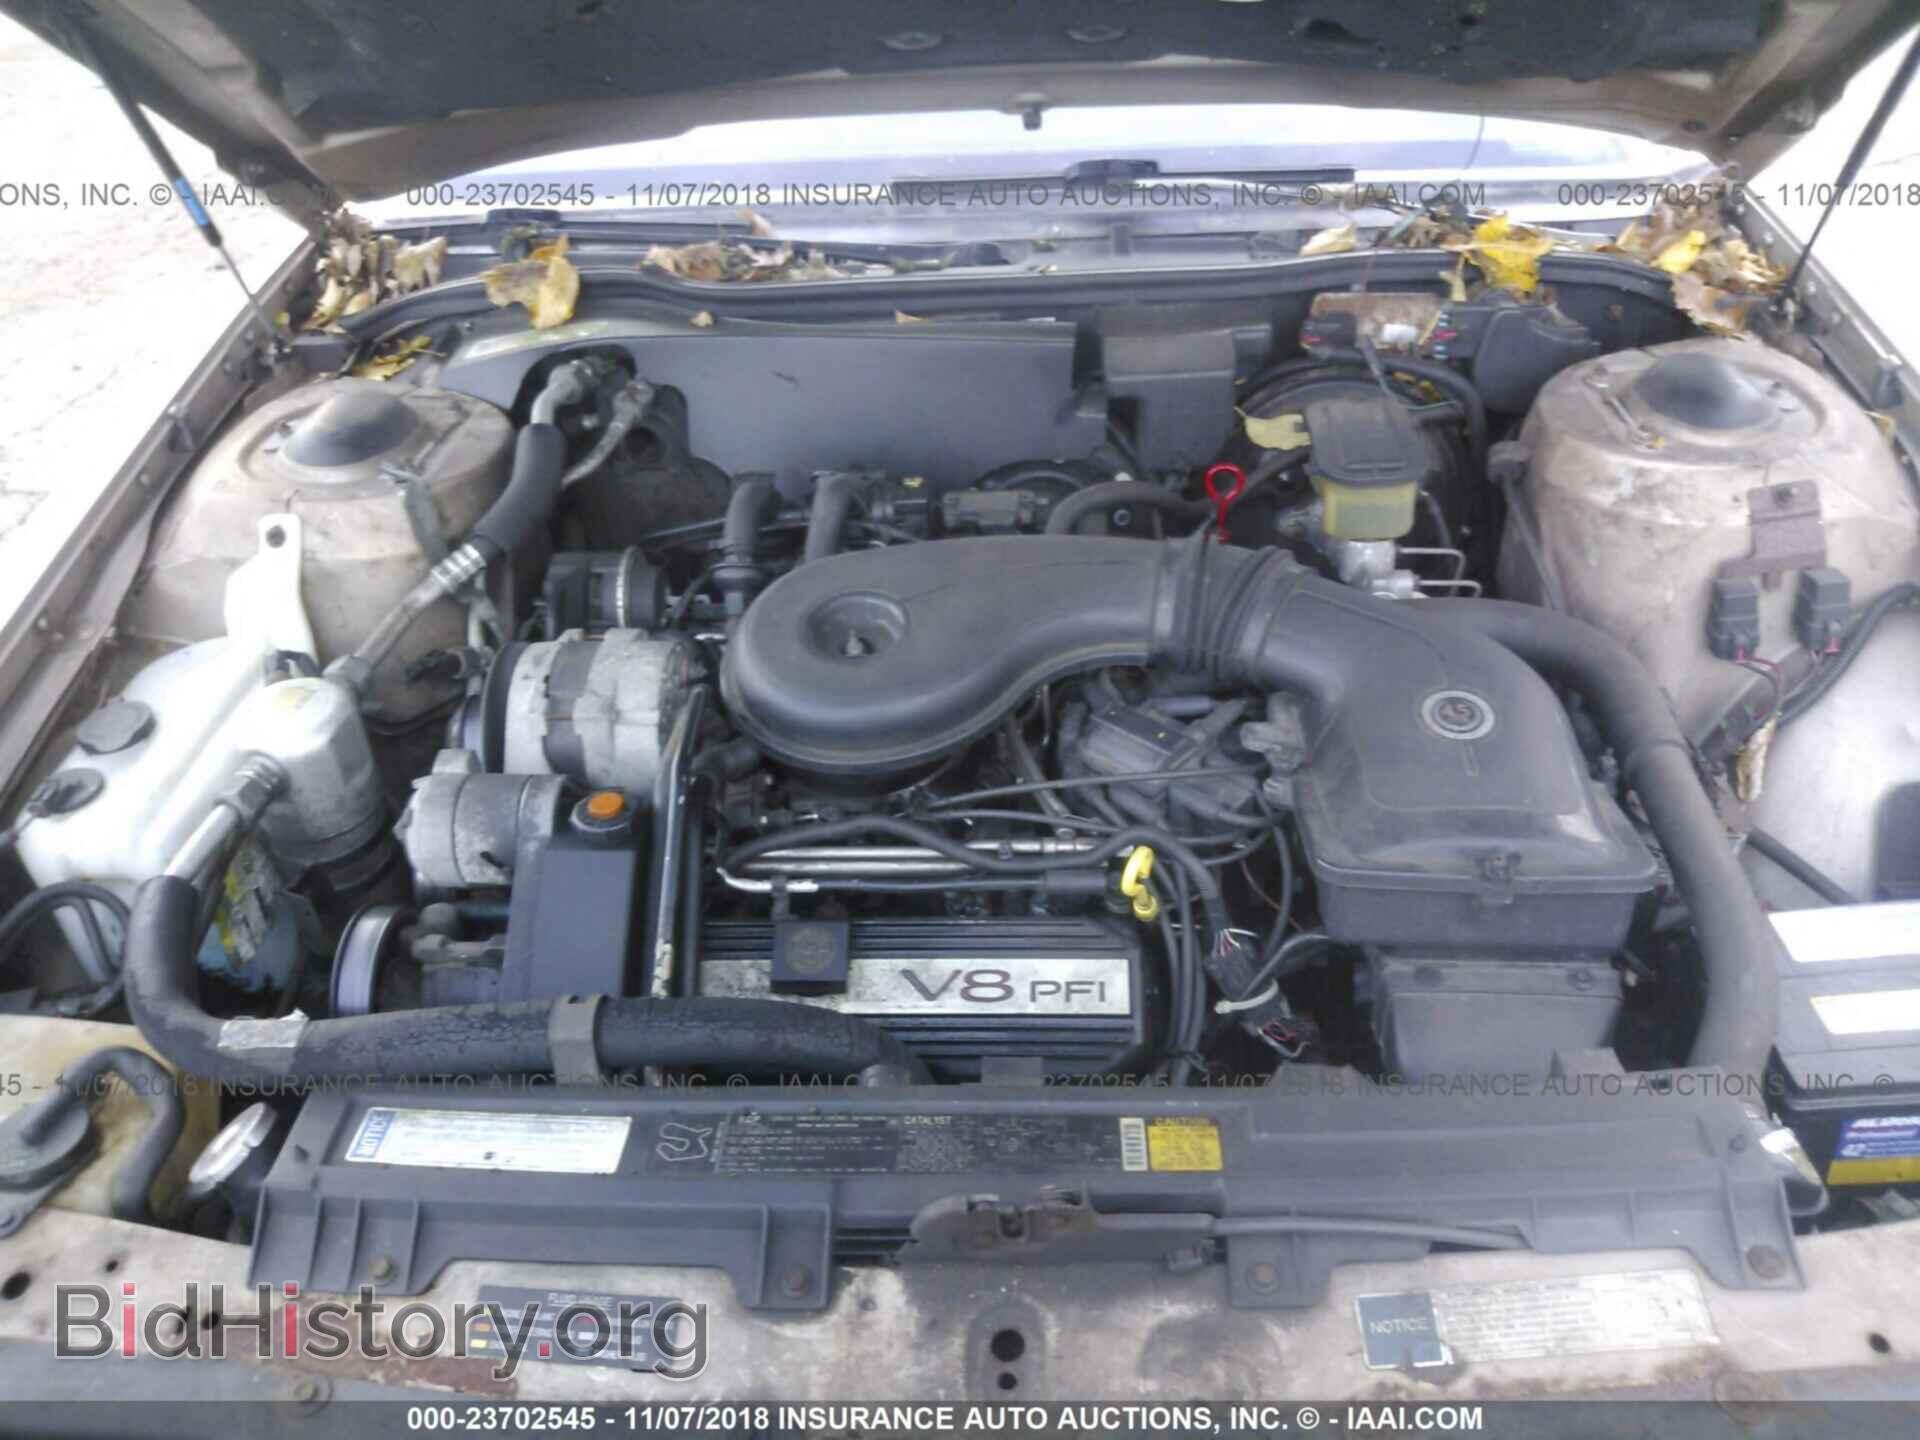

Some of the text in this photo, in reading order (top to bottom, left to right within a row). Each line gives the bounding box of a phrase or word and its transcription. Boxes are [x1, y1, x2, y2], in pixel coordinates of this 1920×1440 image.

[901, 968, 1106, 1003] V8 PFI
[1368, 1316, 1429, 1334] NOTICE
